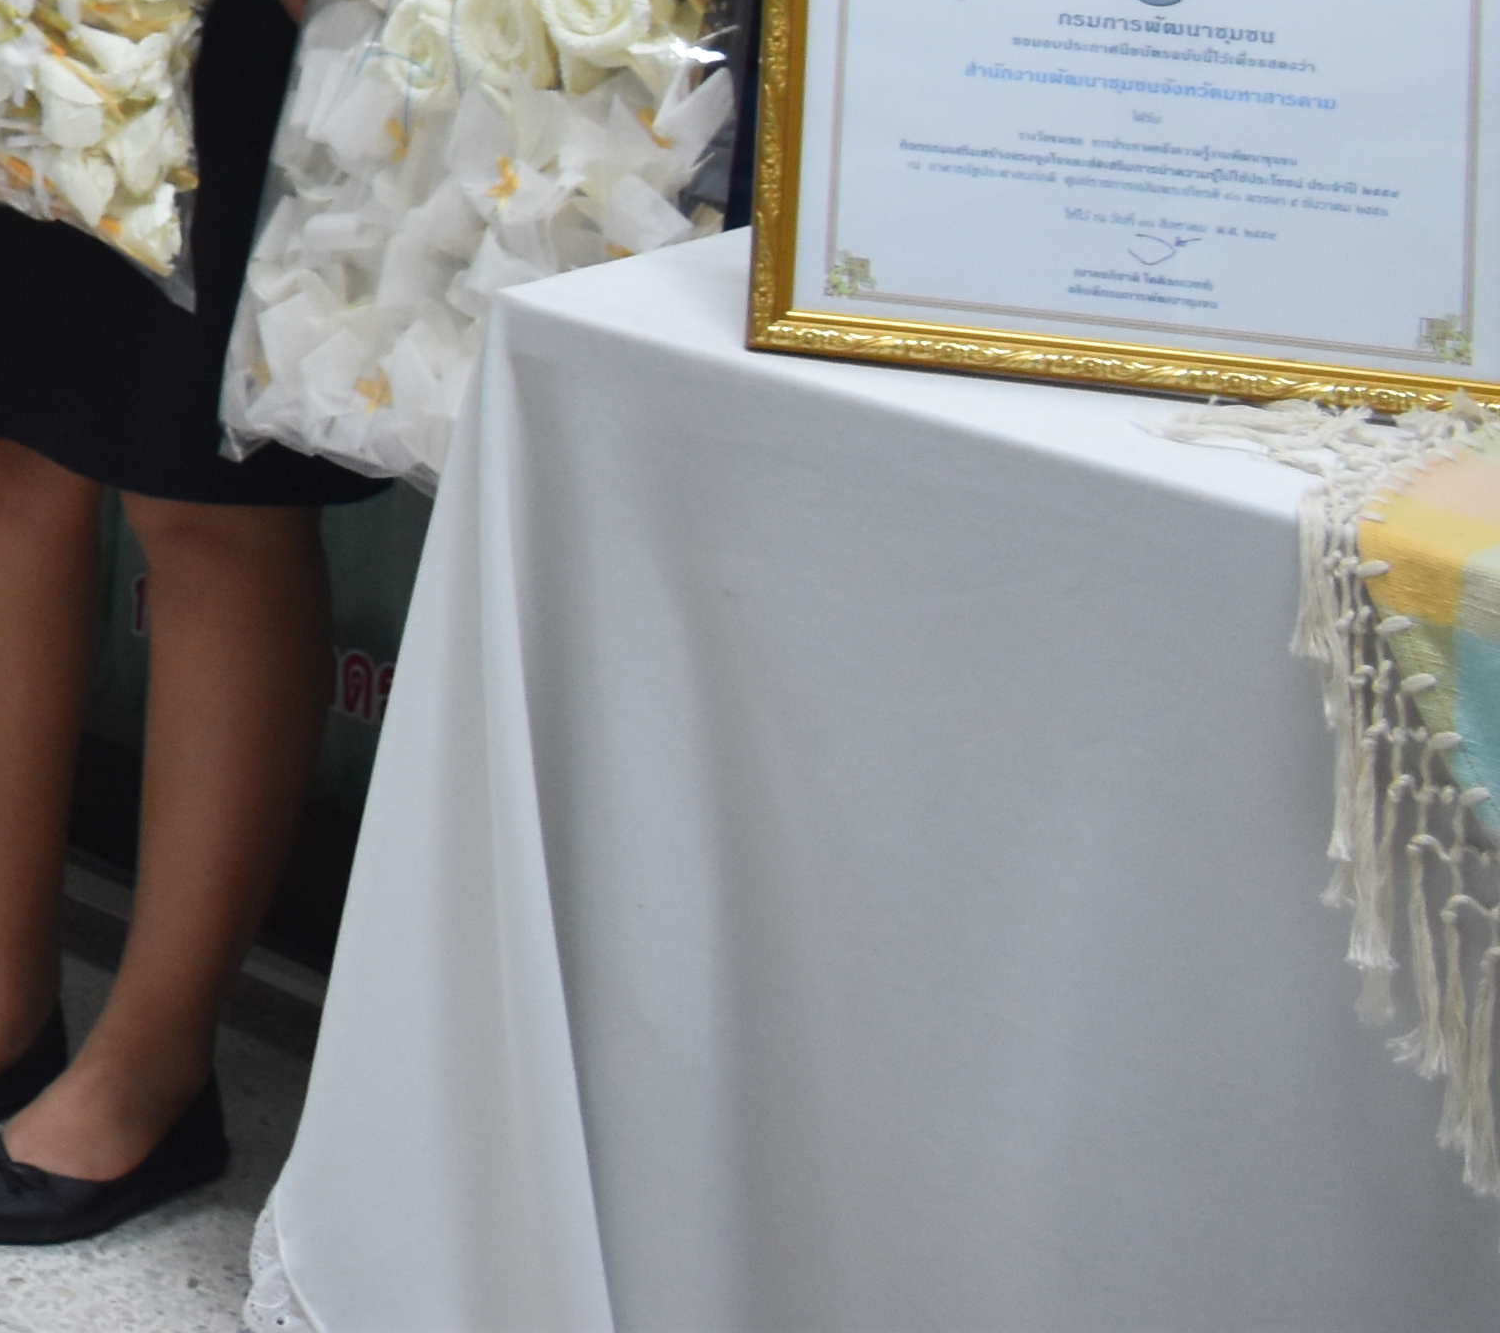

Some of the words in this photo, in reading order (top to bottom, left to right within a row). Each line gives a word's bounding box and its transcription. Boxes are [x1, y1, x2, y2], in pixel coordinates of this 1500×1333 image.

[1057, 12, 1276, 44] กรมการพัฒนาชุมชน
